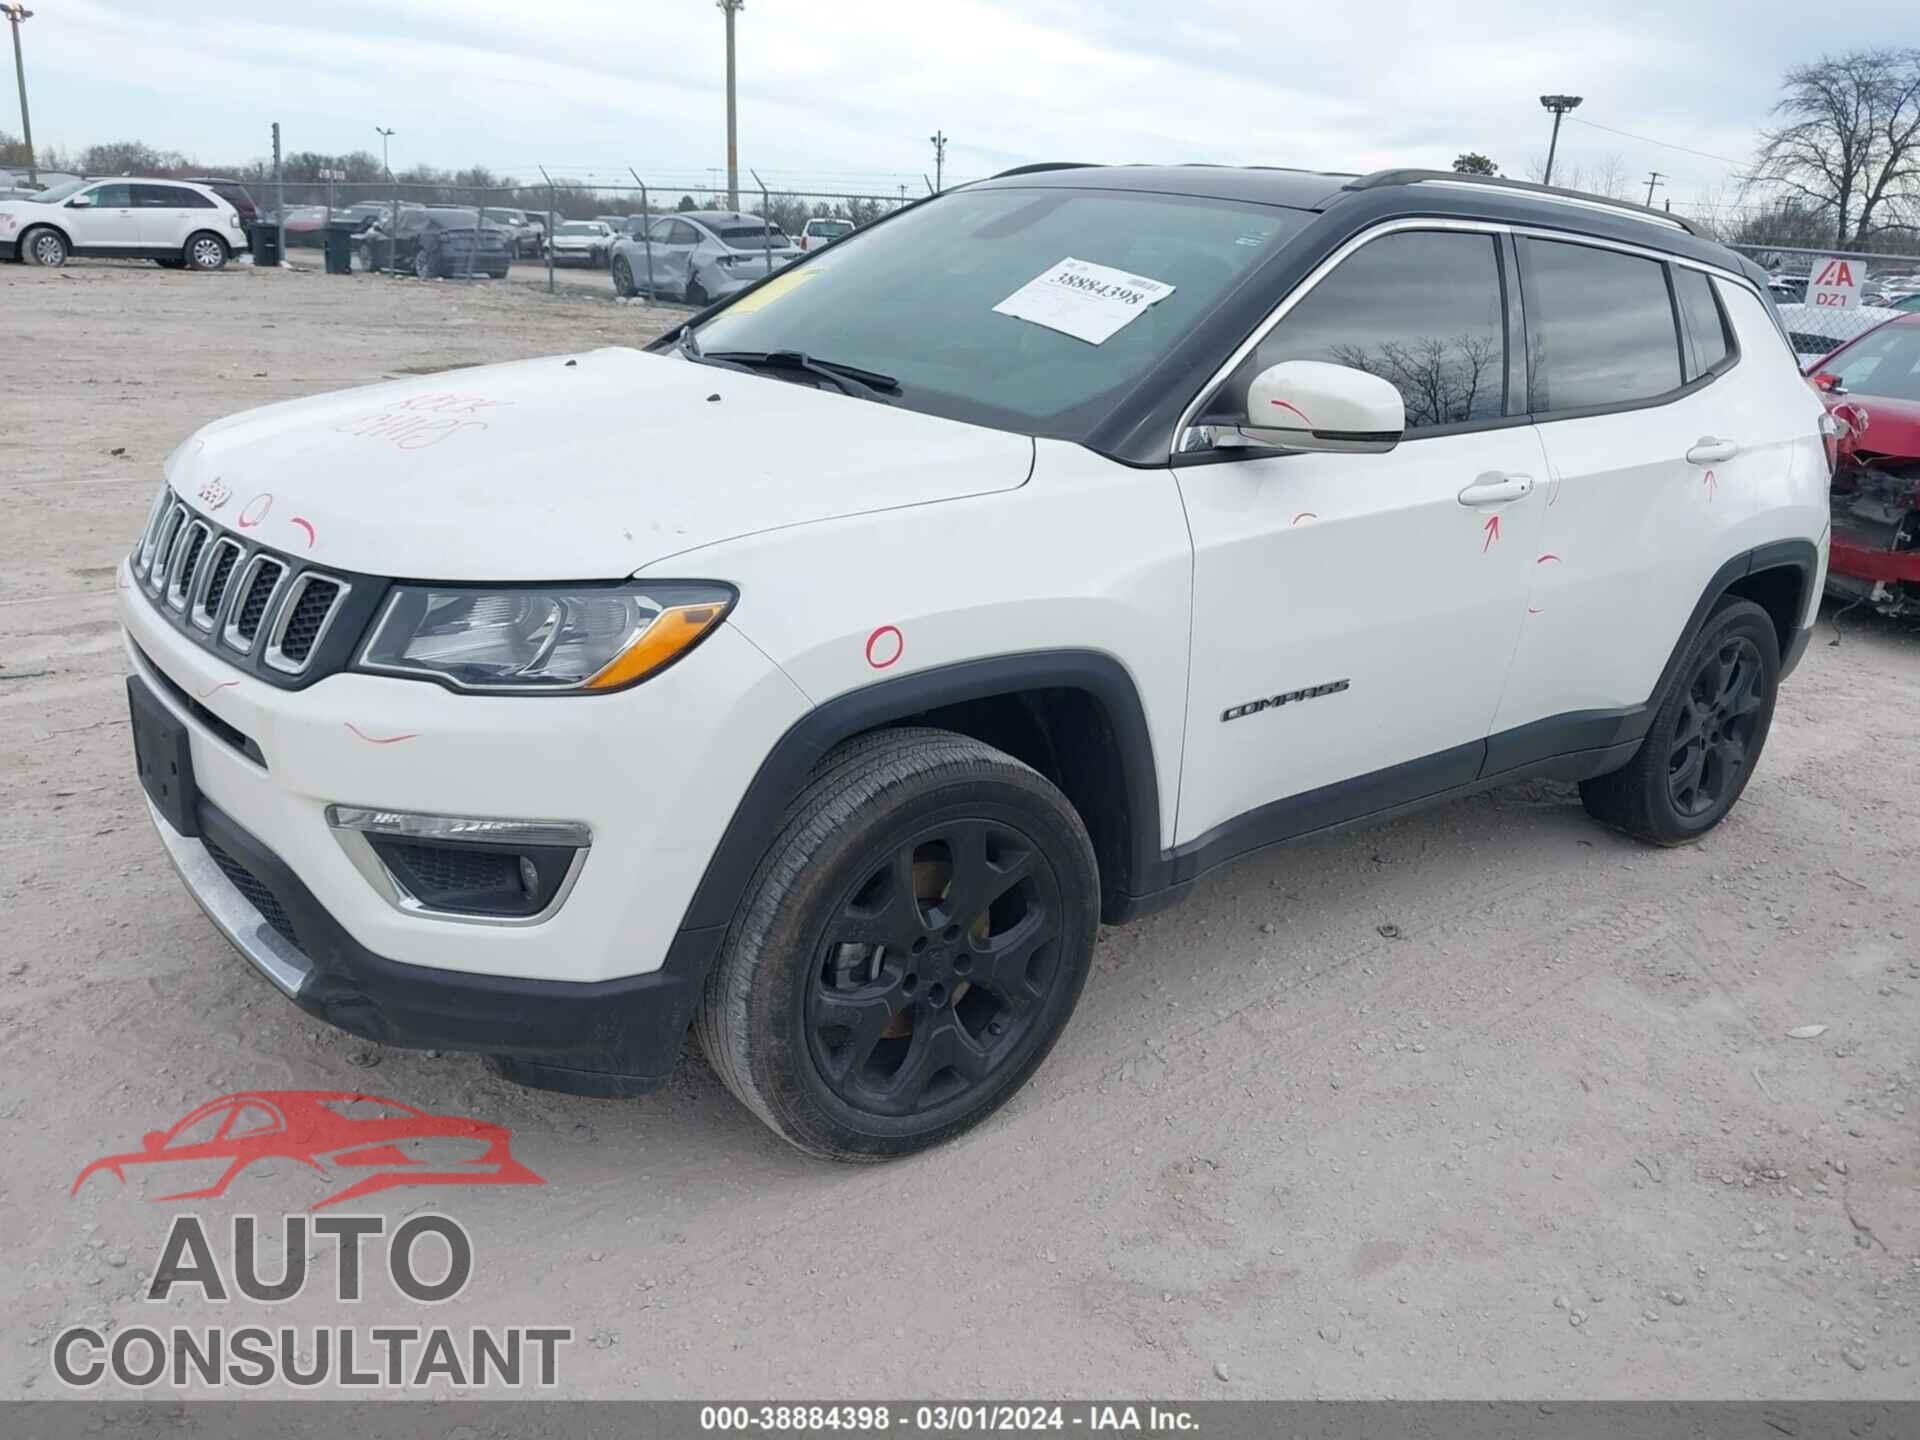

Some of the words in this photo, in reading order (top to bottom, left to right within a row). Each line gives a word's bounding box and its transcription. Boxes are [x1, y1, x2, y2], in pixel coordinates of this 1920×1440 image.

[1049, 272, 1145, 305] 38884398
[1815, 292, 1848, 307] DZ1
[1220, 678, 1351, 722] COMPASS
